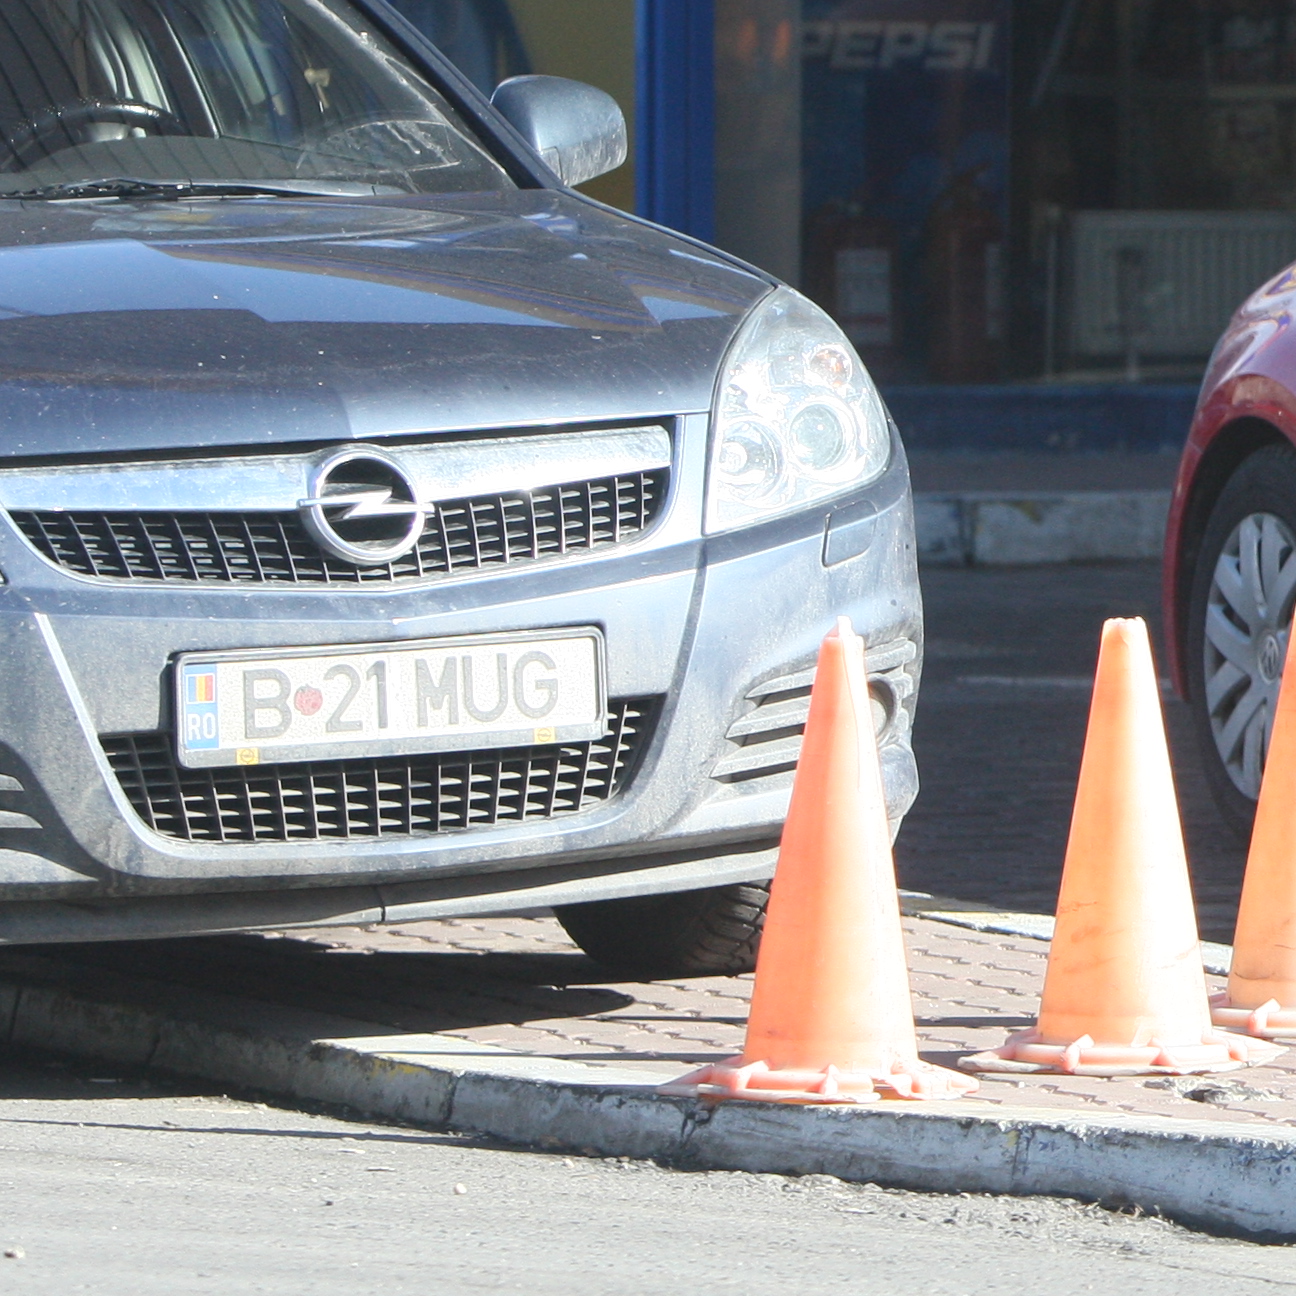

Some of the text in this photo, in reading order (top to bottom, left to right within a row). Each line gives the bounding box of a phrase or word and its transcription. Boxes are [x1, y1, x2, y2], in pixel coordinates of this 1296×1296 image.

[797, 20, 996, 69] PEPSI
[243, 650, 559, 740] B 21 MUG
[186, 712, 217, 741] RO
